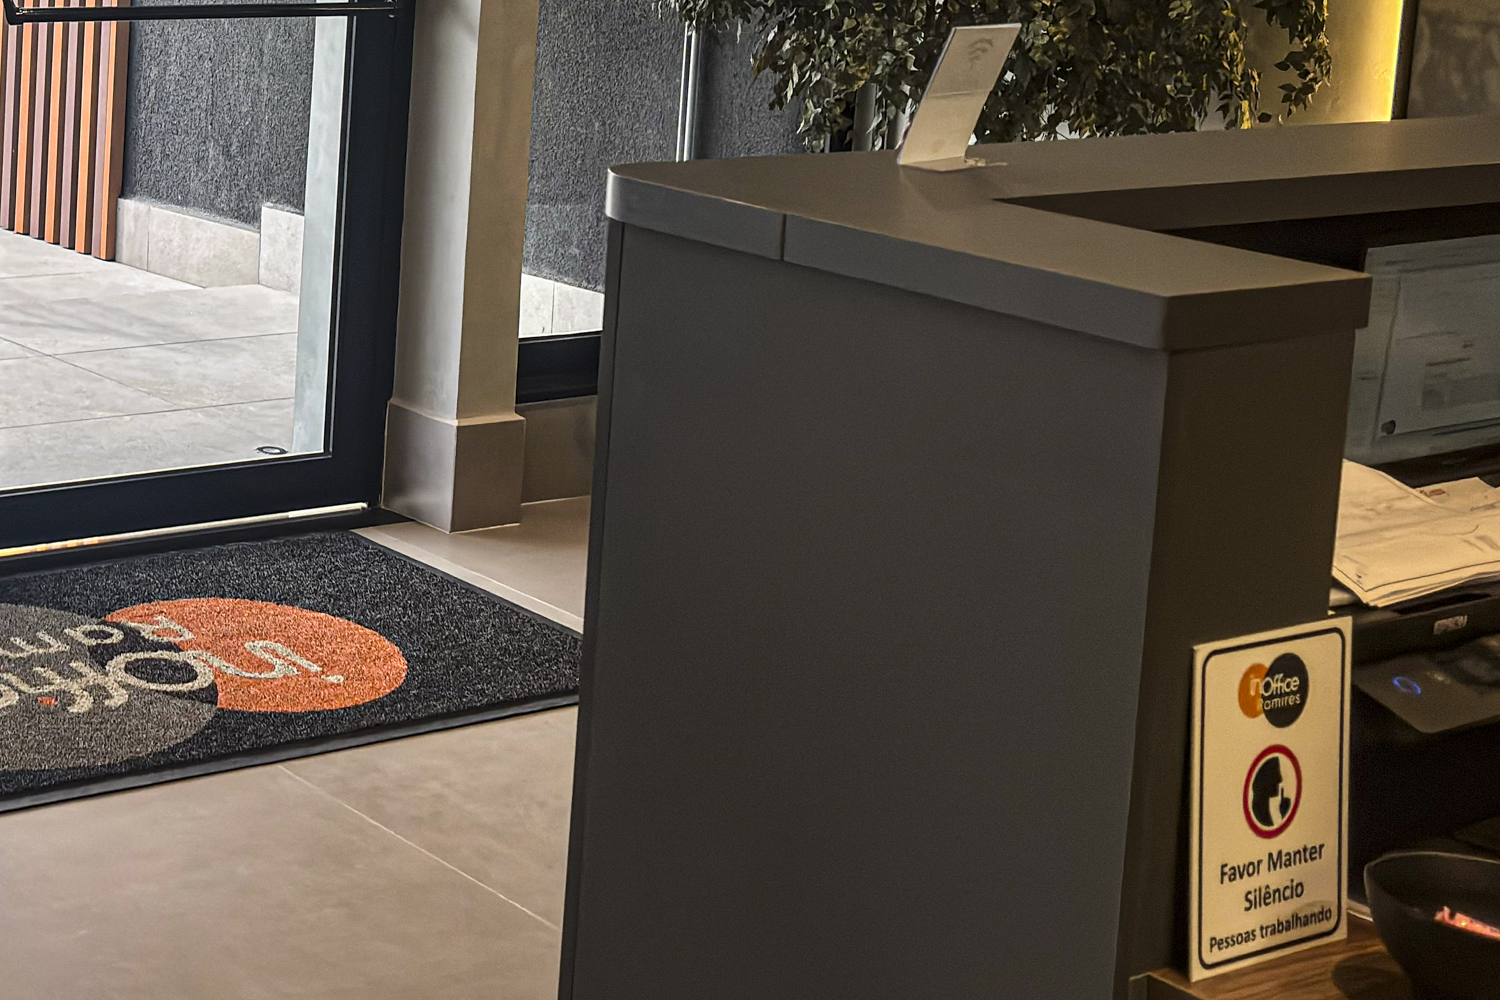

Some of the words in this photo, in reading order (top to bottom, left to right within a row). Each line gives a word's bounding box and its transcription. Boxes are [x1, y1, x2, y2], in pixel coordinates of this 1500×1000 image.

[1257, 693, 1301, 713] Ramires
[1220, 861, 1263, 885] Favor
[1267, 843, 1325, 872] Manter
[1244, 879, 1305, 912] Silêncio
[1209, 925, 1256, 953] Pessoas
[1260, 906, 1332, 941] trabalhando
